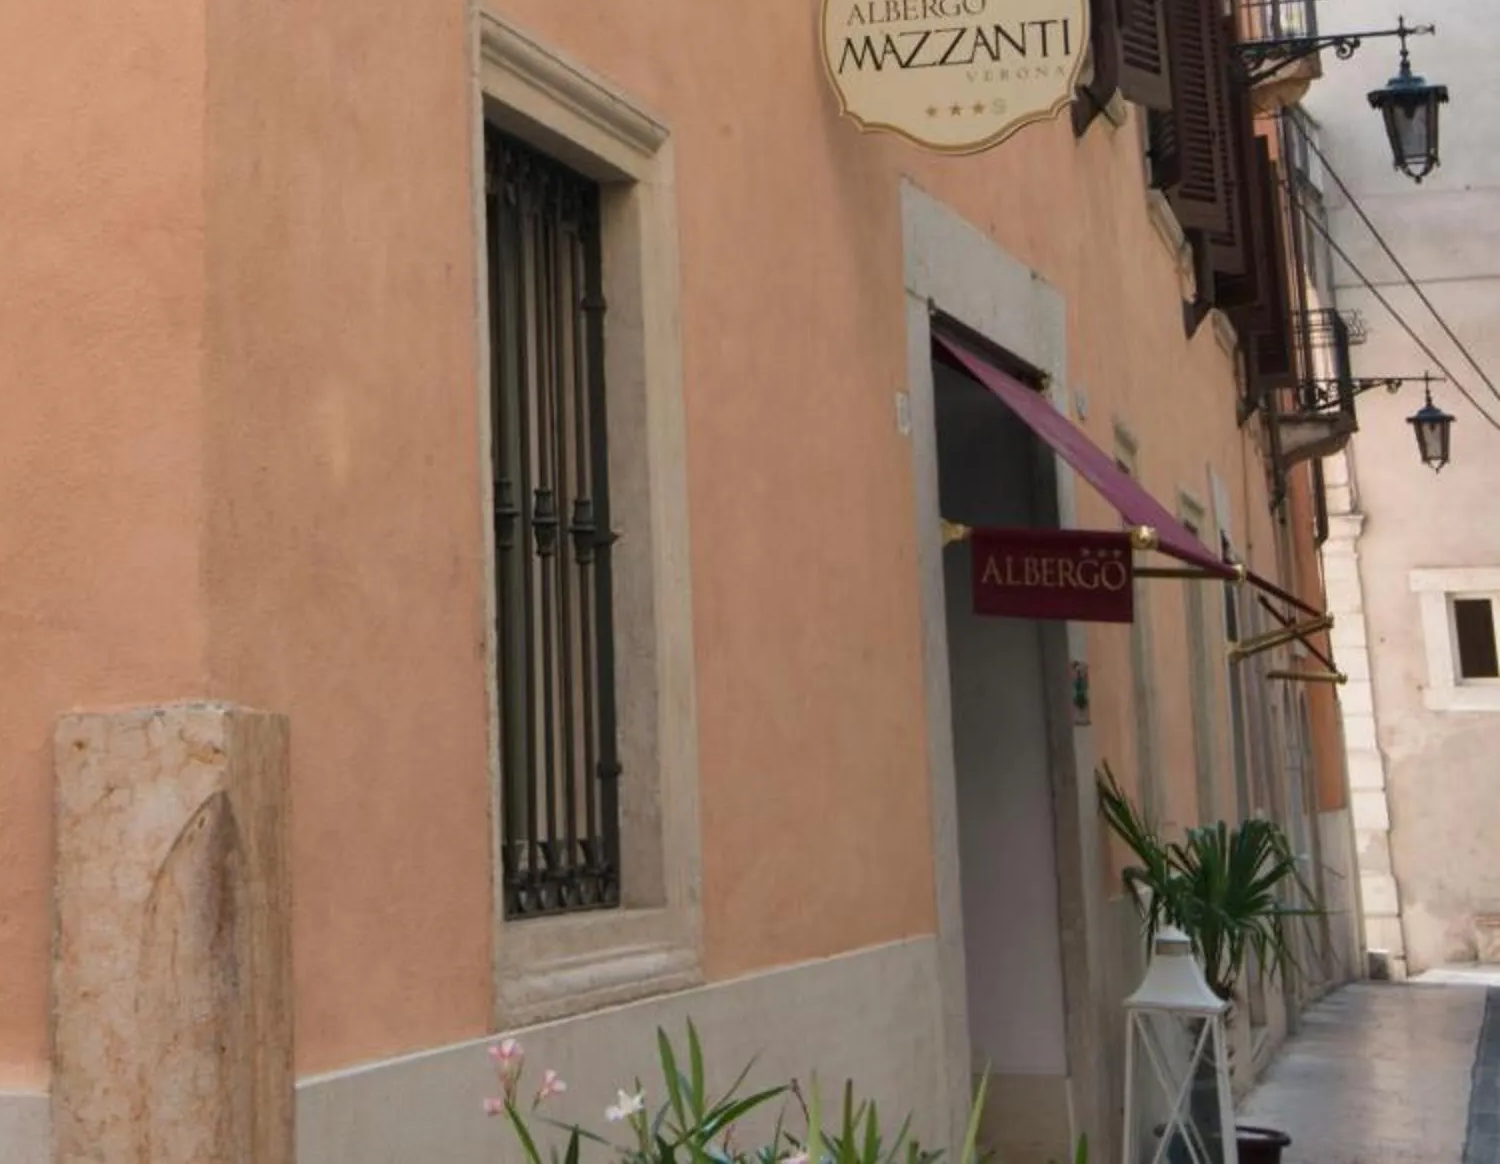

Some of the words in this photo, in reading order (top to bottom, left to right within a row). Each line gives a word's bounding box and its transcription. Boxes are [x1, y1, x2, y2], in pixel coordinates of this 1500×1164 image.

[838, 18, 1071, 75] MAZZANTI
[965, 66, 1066, 84] VERONA
[982, 555, 1127, 591] ALBERGO
